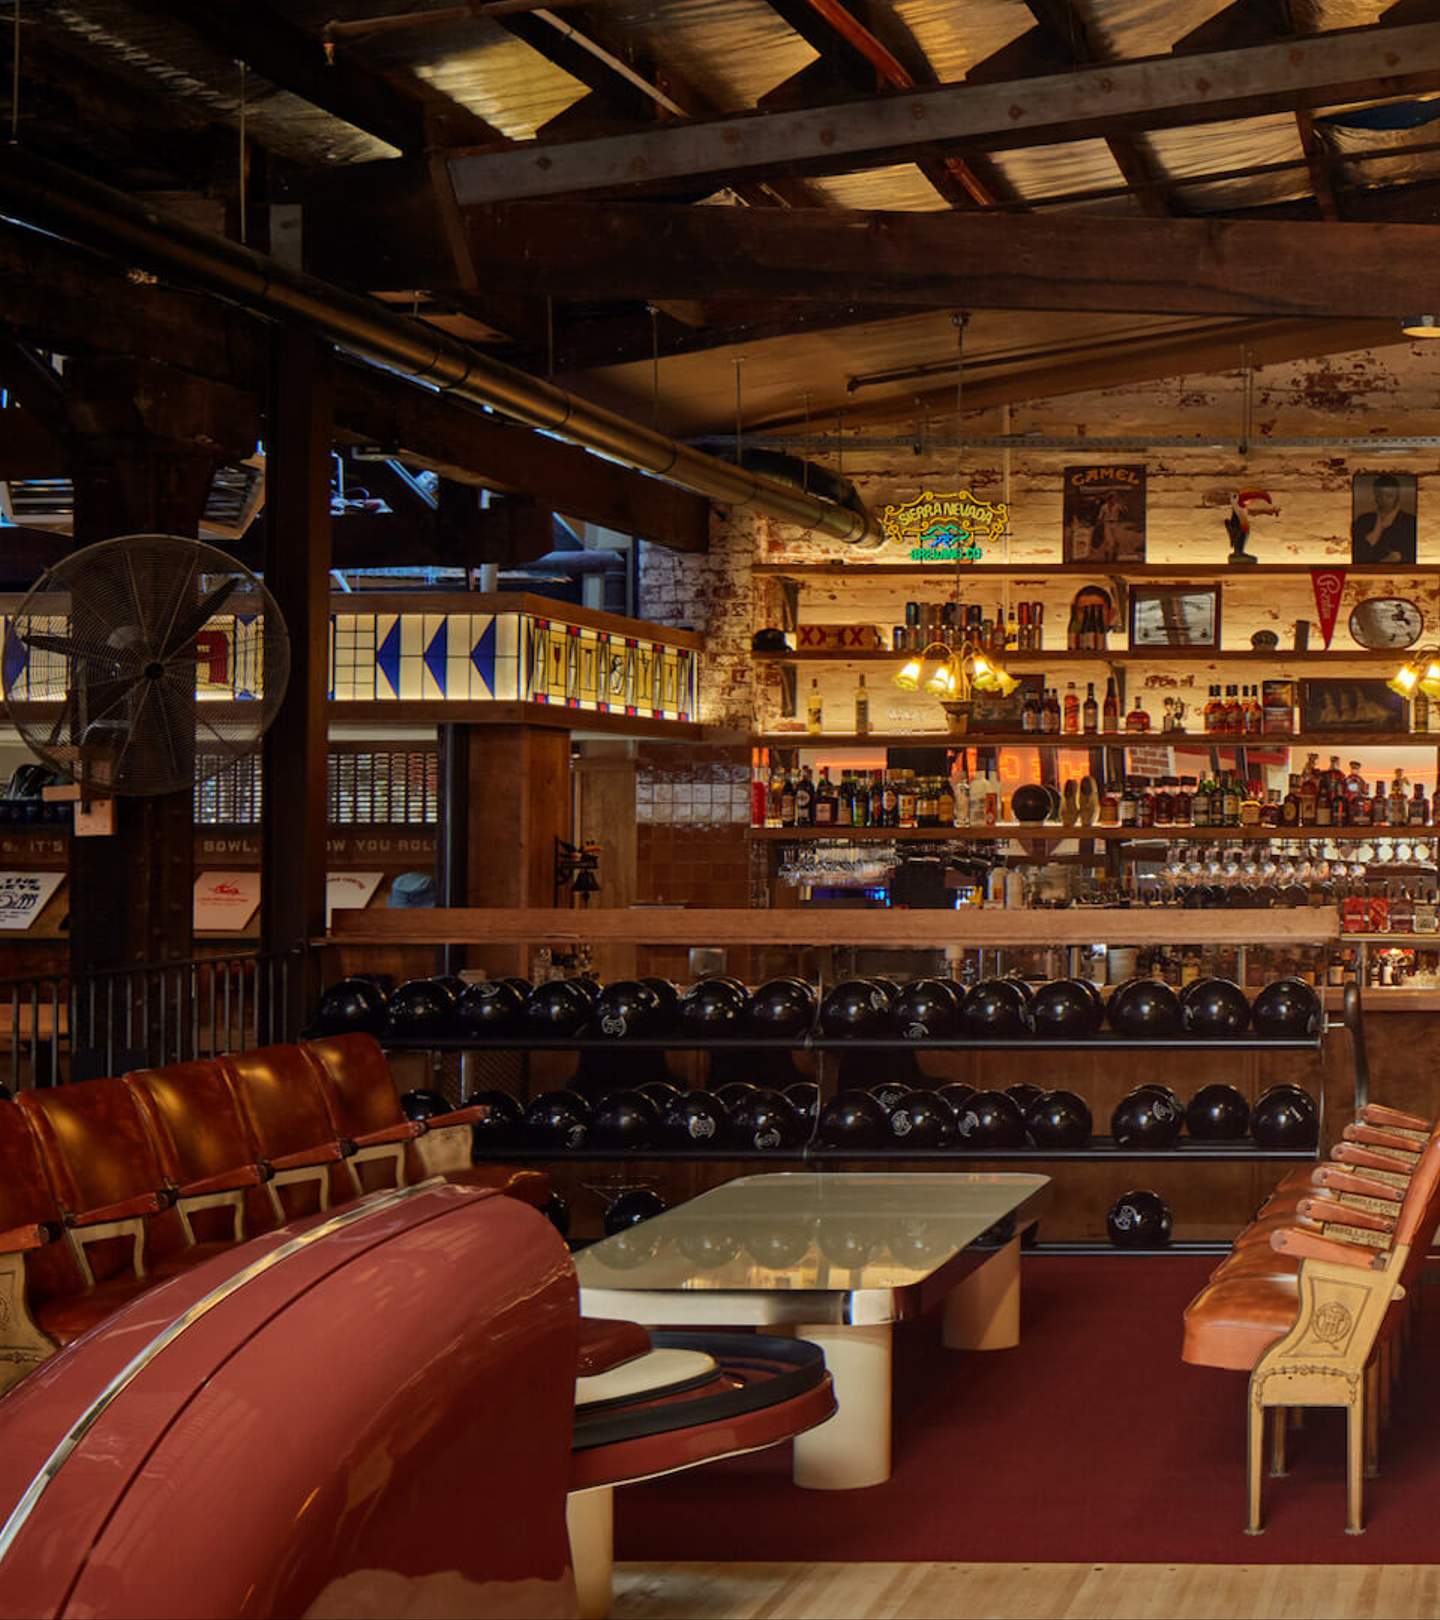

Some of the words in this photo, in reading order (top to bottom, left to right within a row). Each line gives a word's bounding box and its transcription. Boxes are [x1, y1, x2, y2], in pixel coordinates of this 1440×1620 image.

[1071, 469, 1140, 486] CAMEL
[898, 503, 942, 526] SIERRA
[943, 502, 993, 525] NEVADA
[356, 840, 391, 851] YOU
